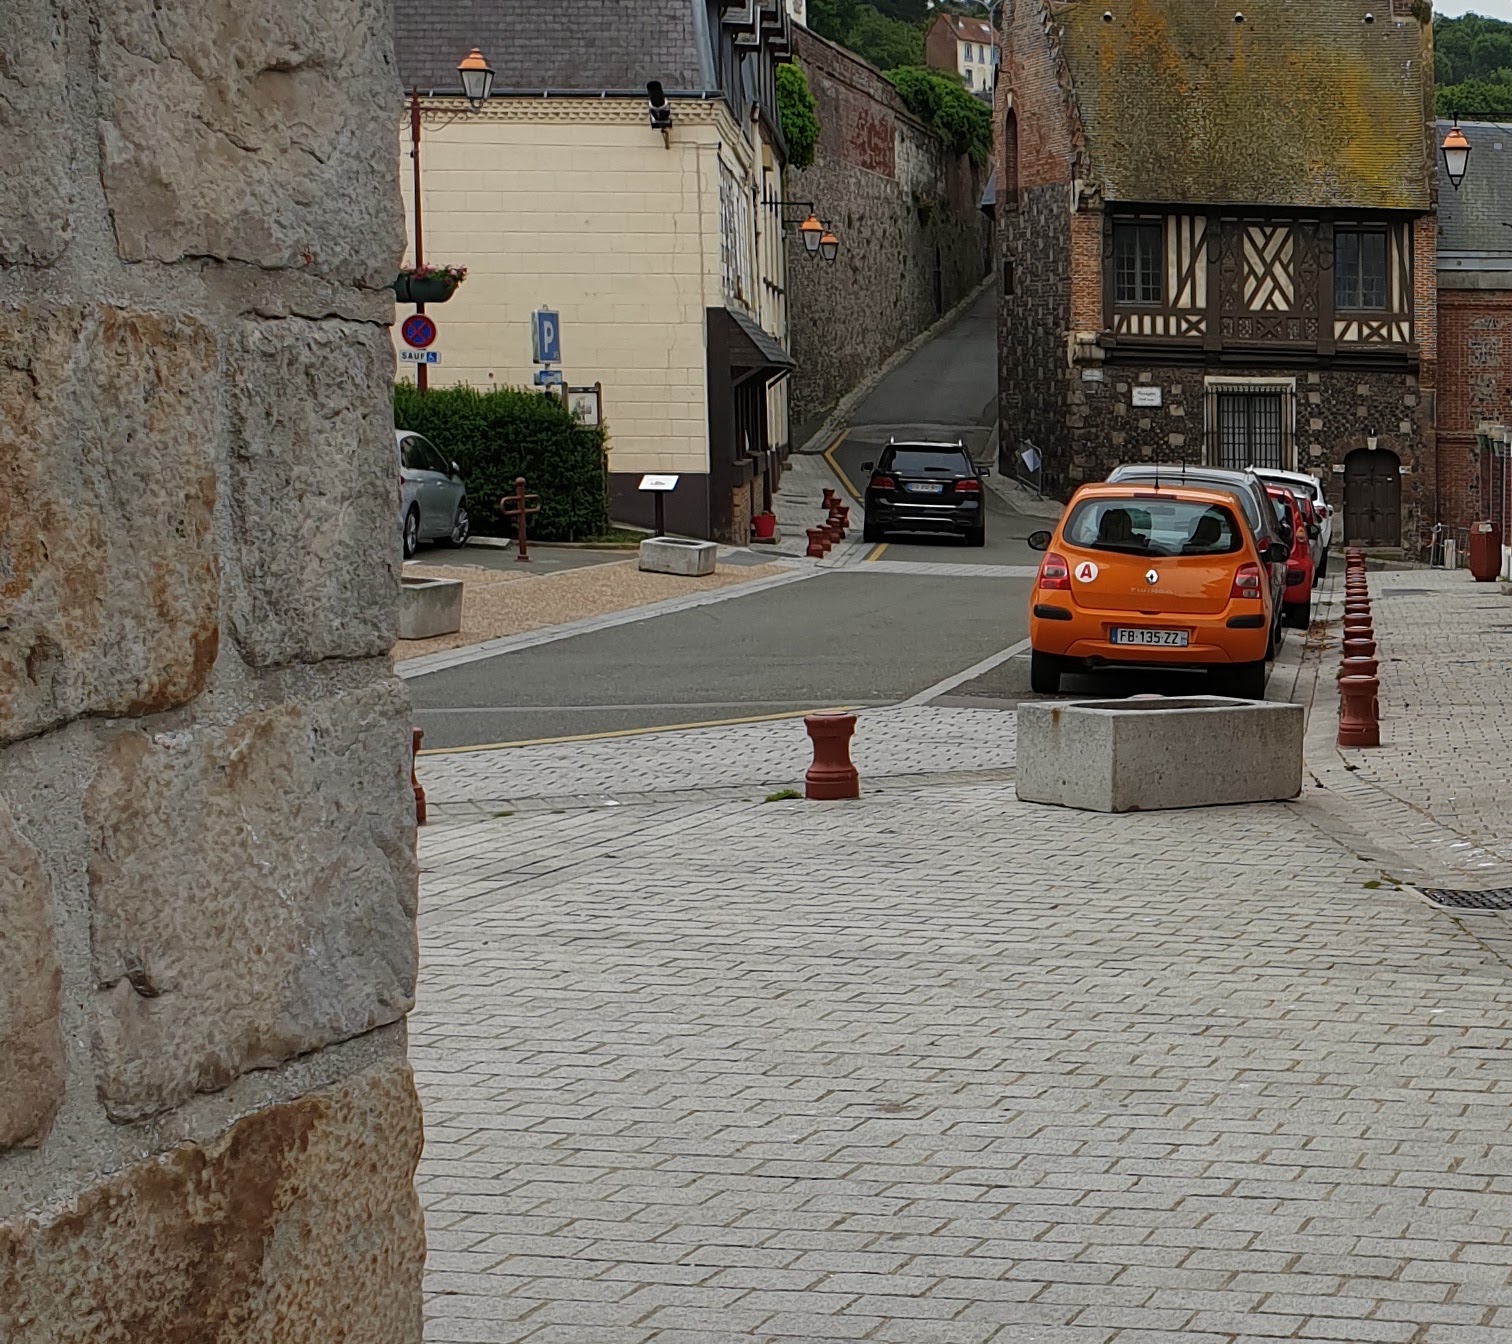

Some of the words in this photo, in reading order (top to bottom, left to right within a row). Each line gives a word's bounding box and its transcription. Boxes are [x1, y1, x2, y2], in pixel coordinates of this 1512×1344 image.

[543, 321, 554, 353] P
[401, 351, 425, 360] SAUF
[1080, 563, 1092, 579] A
